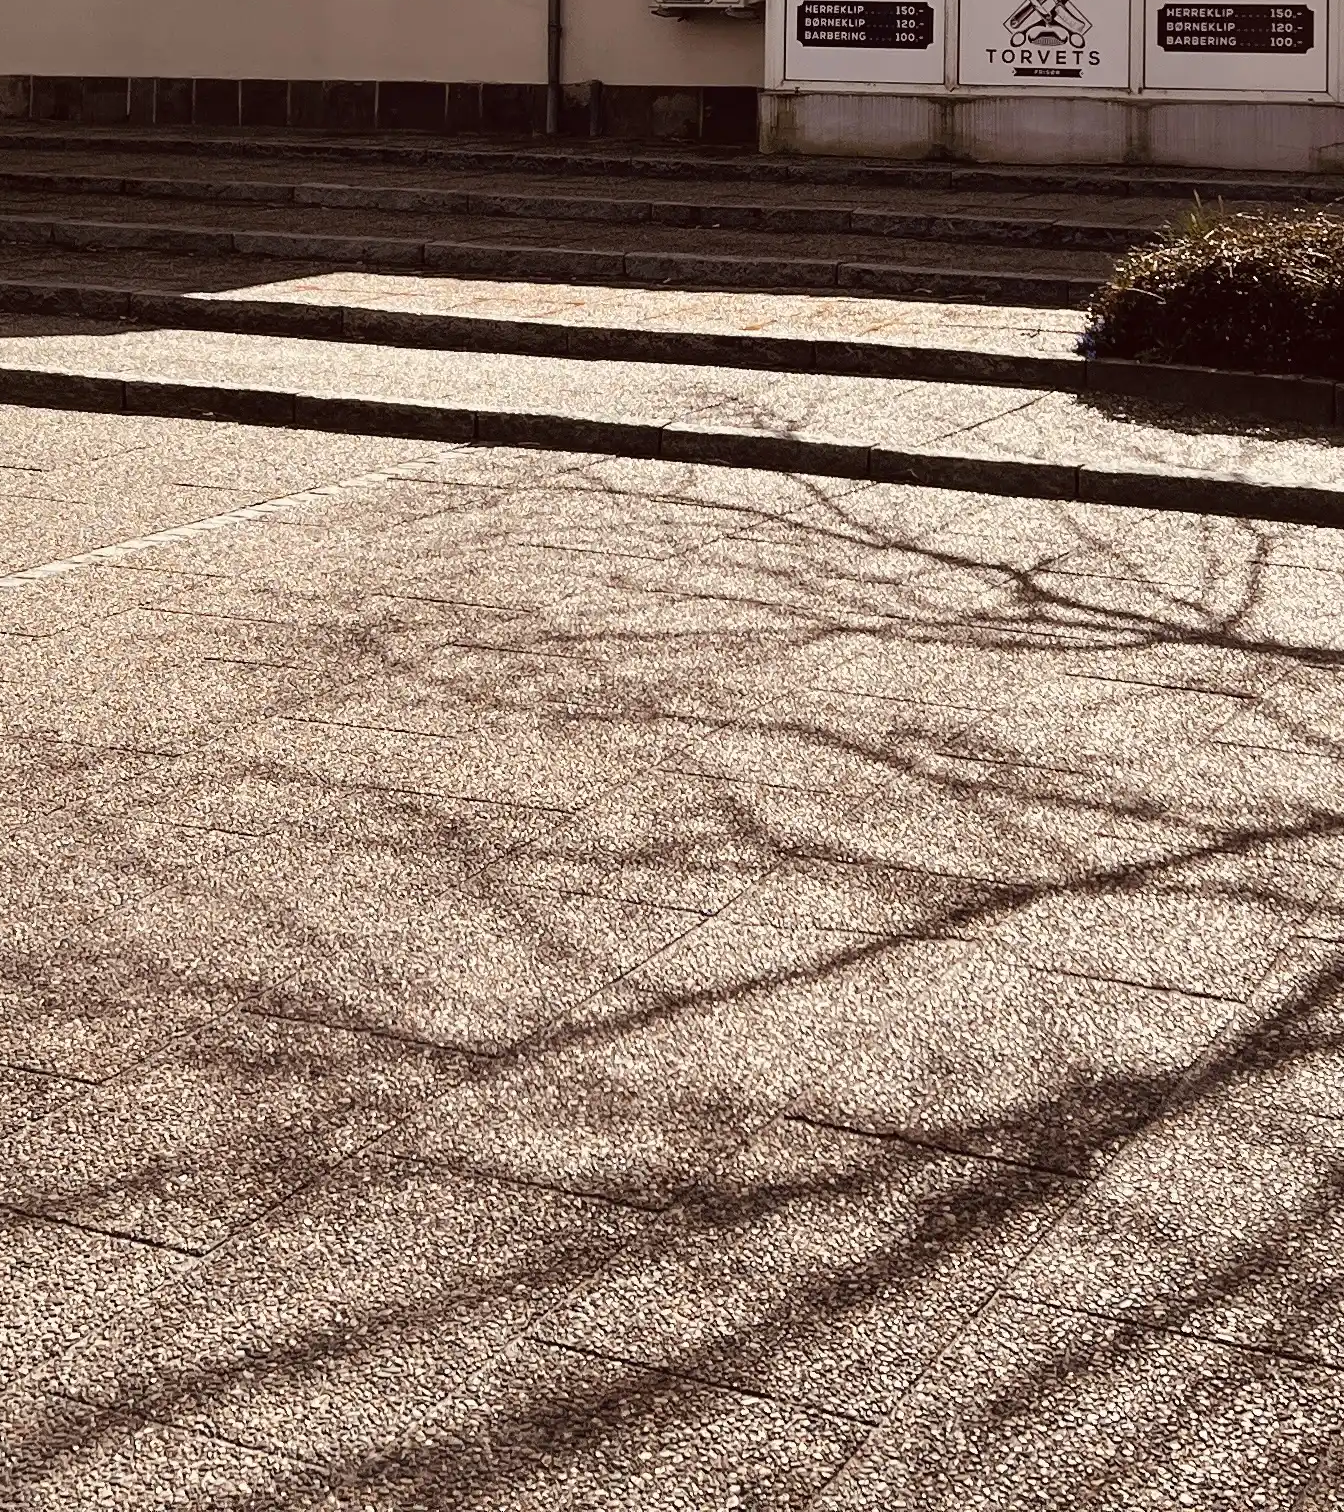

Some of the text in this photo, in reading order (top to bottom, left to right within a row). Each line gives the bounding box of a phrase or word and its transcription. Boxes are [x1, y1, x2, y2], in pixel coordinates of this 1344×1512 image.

[805, 5, 864, 14] HERREKLIP
[1166, 8, 1234, 17] HERREKLIP
[804, 18, 866, 27] BØRNEKLIP
[1166, 22, 1236, 31] BØRNEKLIP
[804, 31, 866, 40] BARBERING
[1166, 36, 1237, 46] BARBERING
[986, 49, 1100, 65] TORVETS
